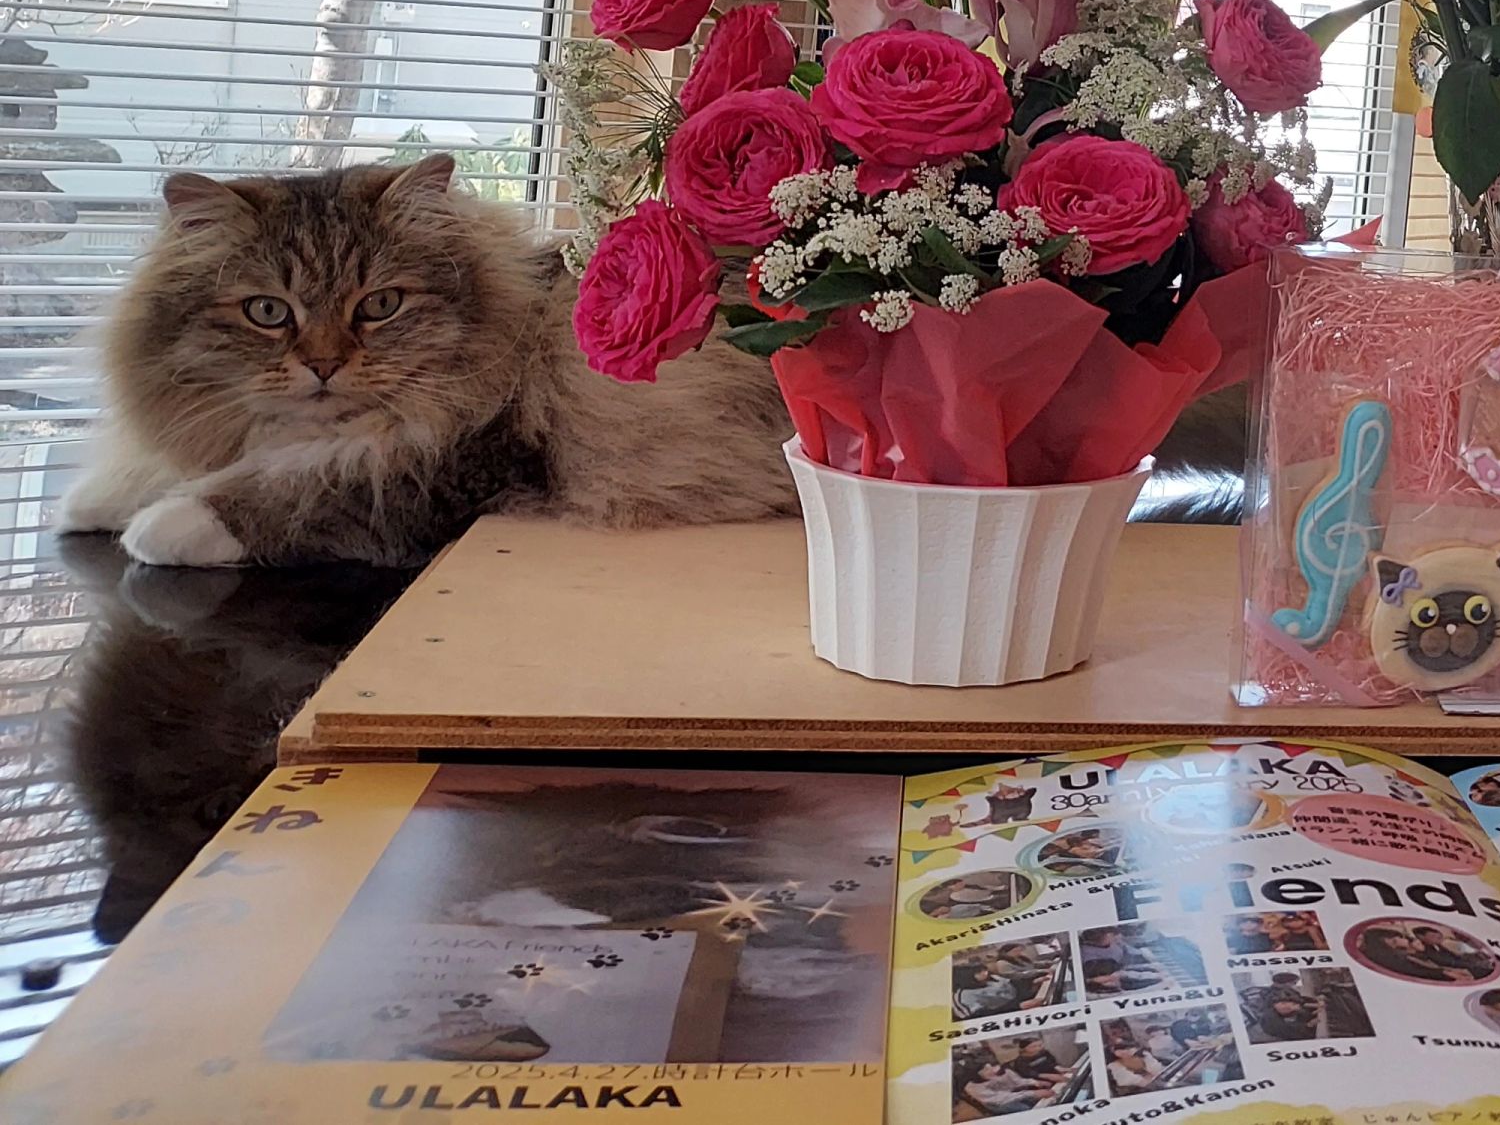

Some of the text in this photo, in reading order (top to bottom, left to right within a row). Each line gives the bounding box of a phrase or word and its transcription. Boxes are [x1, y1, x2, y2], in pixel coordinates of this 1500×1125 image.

[1292, 776, 1364, 794] 2025
[1271, 858, 1332, 874] Atsuki
[914, 899, 1074, 951] Akari&Hinata
[1225, 952, 1334, 969] Masaya
[1112, 986, 1225, 1011] Yuna&U
[927, 1005, 1092, 1042] Sae&Hiyori
[1265, 1044, 1359, 1063] Sou&J
[367, 1084, 683, 1110] ULALAKA
